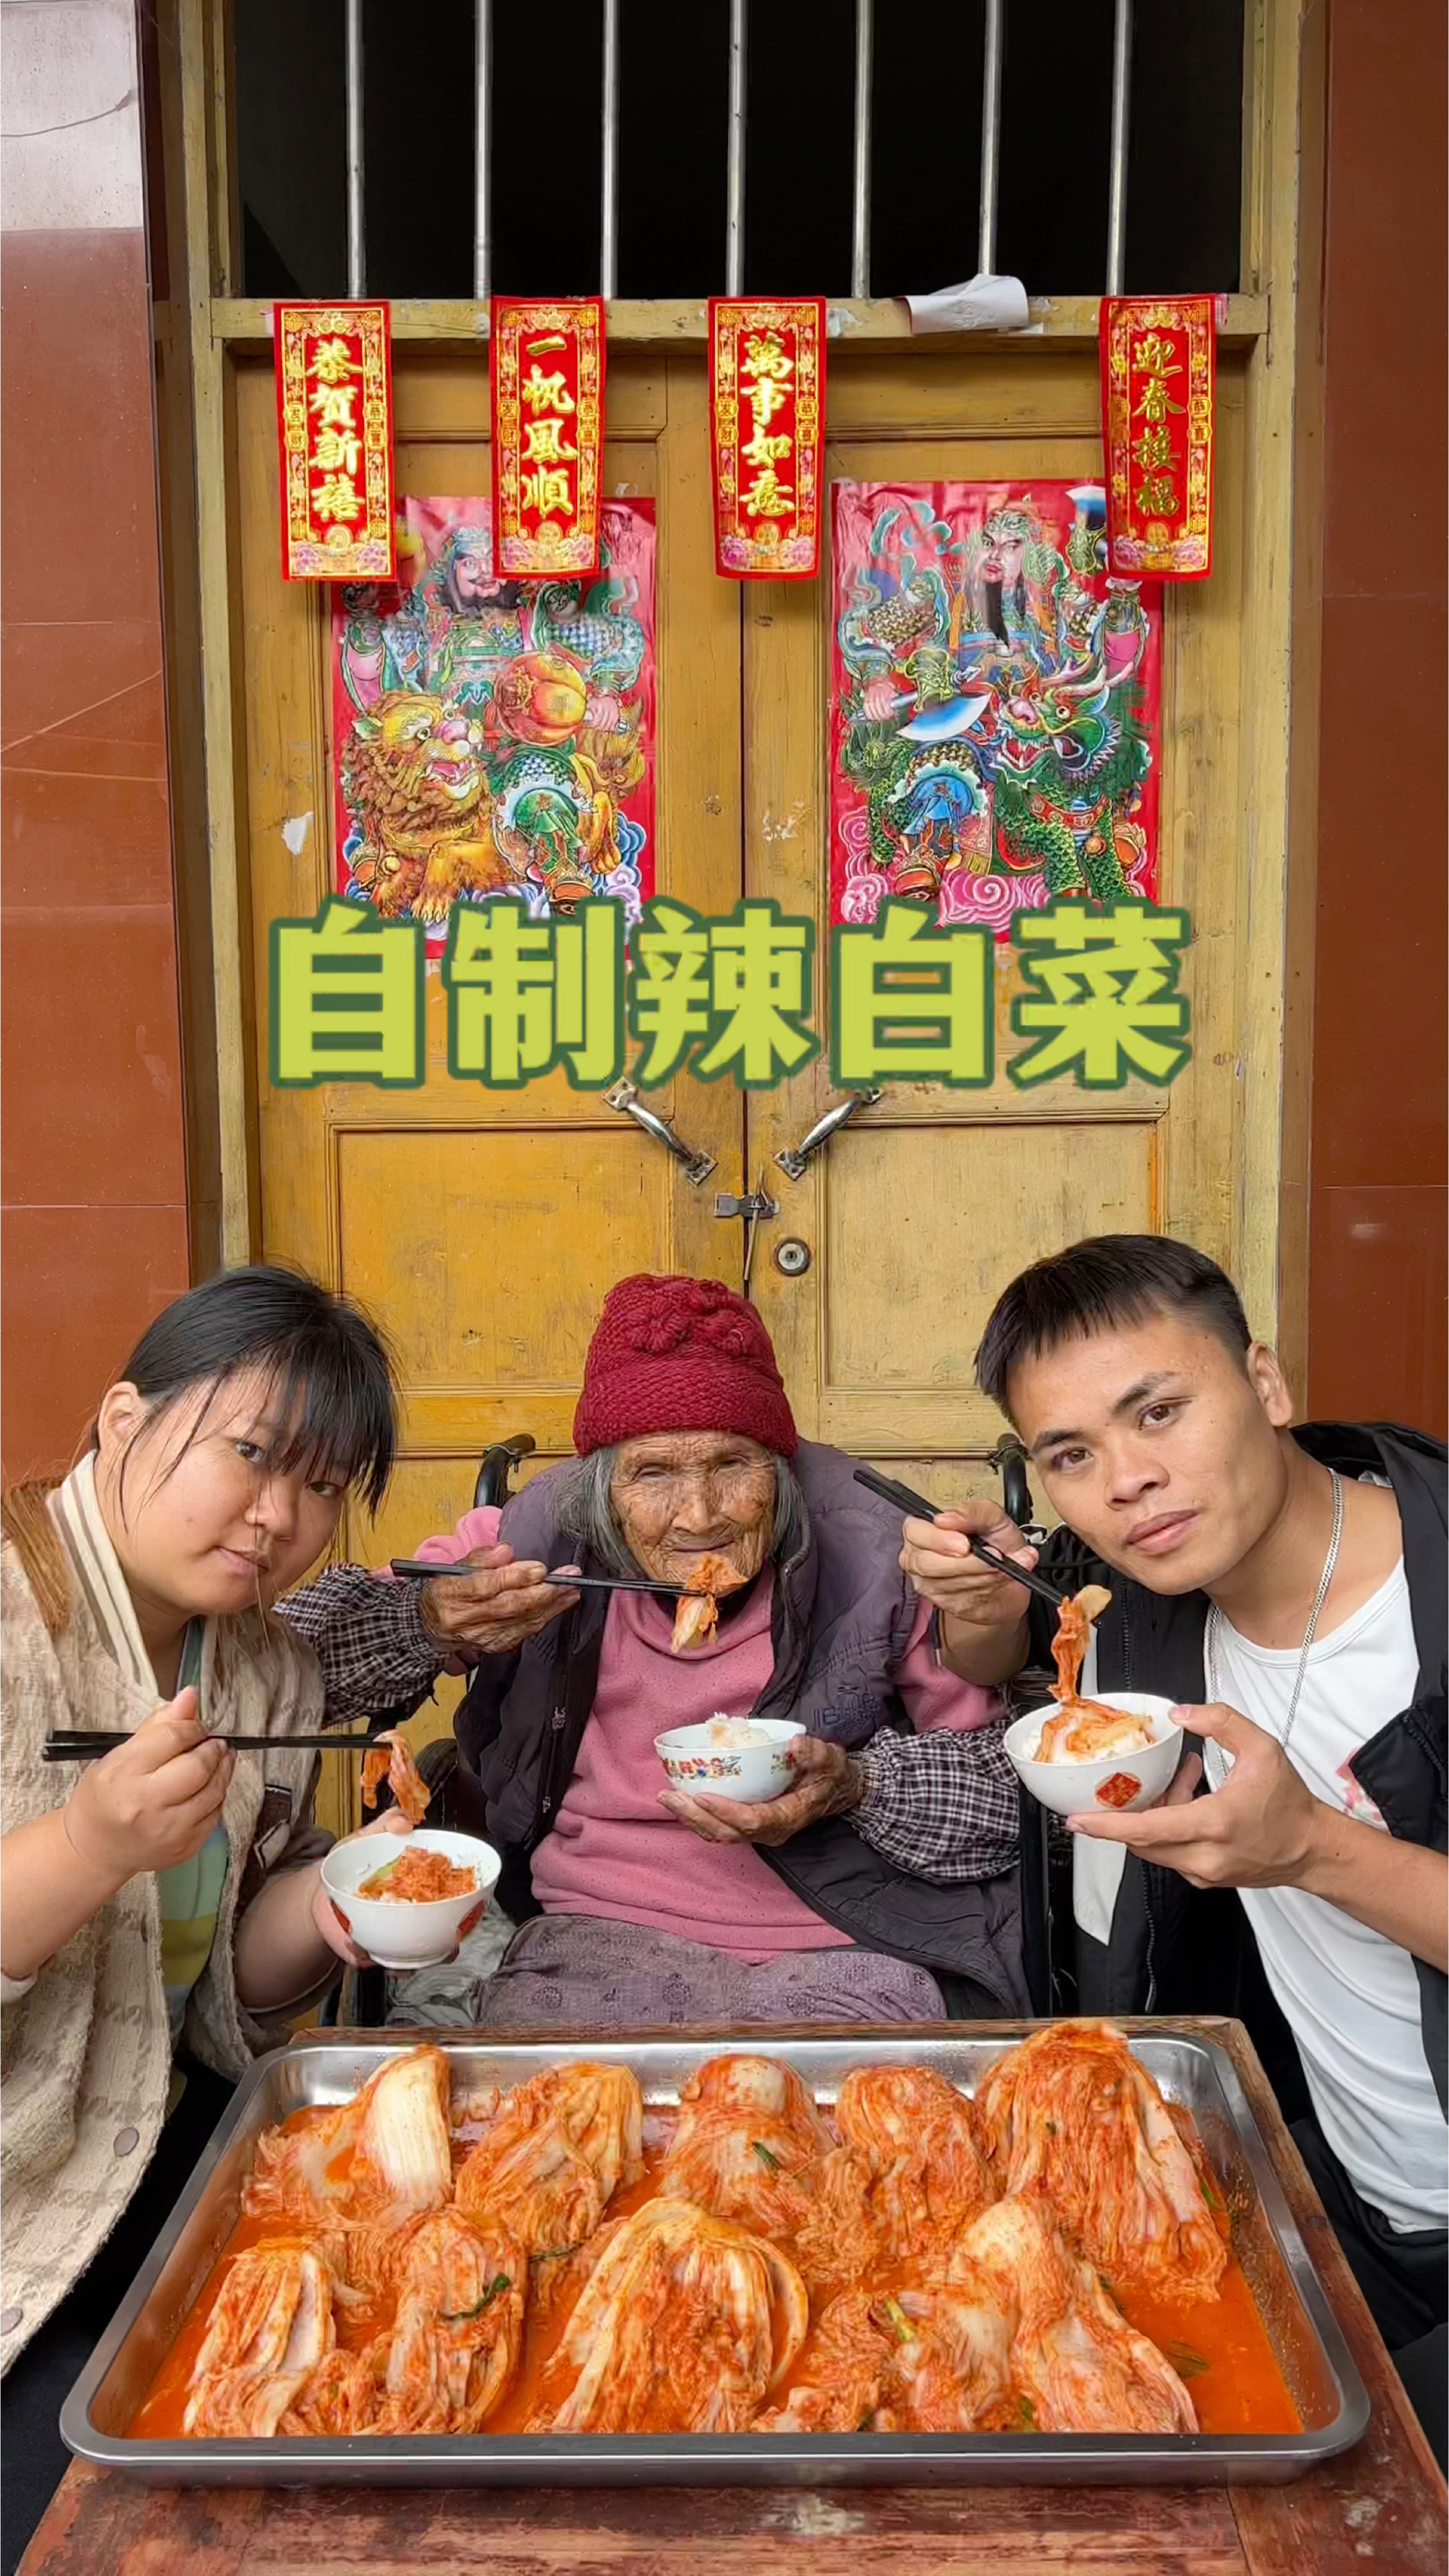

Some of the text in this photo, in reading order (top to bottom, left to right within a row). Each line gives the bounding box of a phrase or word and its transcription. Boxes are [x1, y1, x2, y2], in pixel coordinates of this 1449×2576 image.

[520, 335, 579, 519] 一帆風順
[739, 331, 796, 517] 萬事如意
